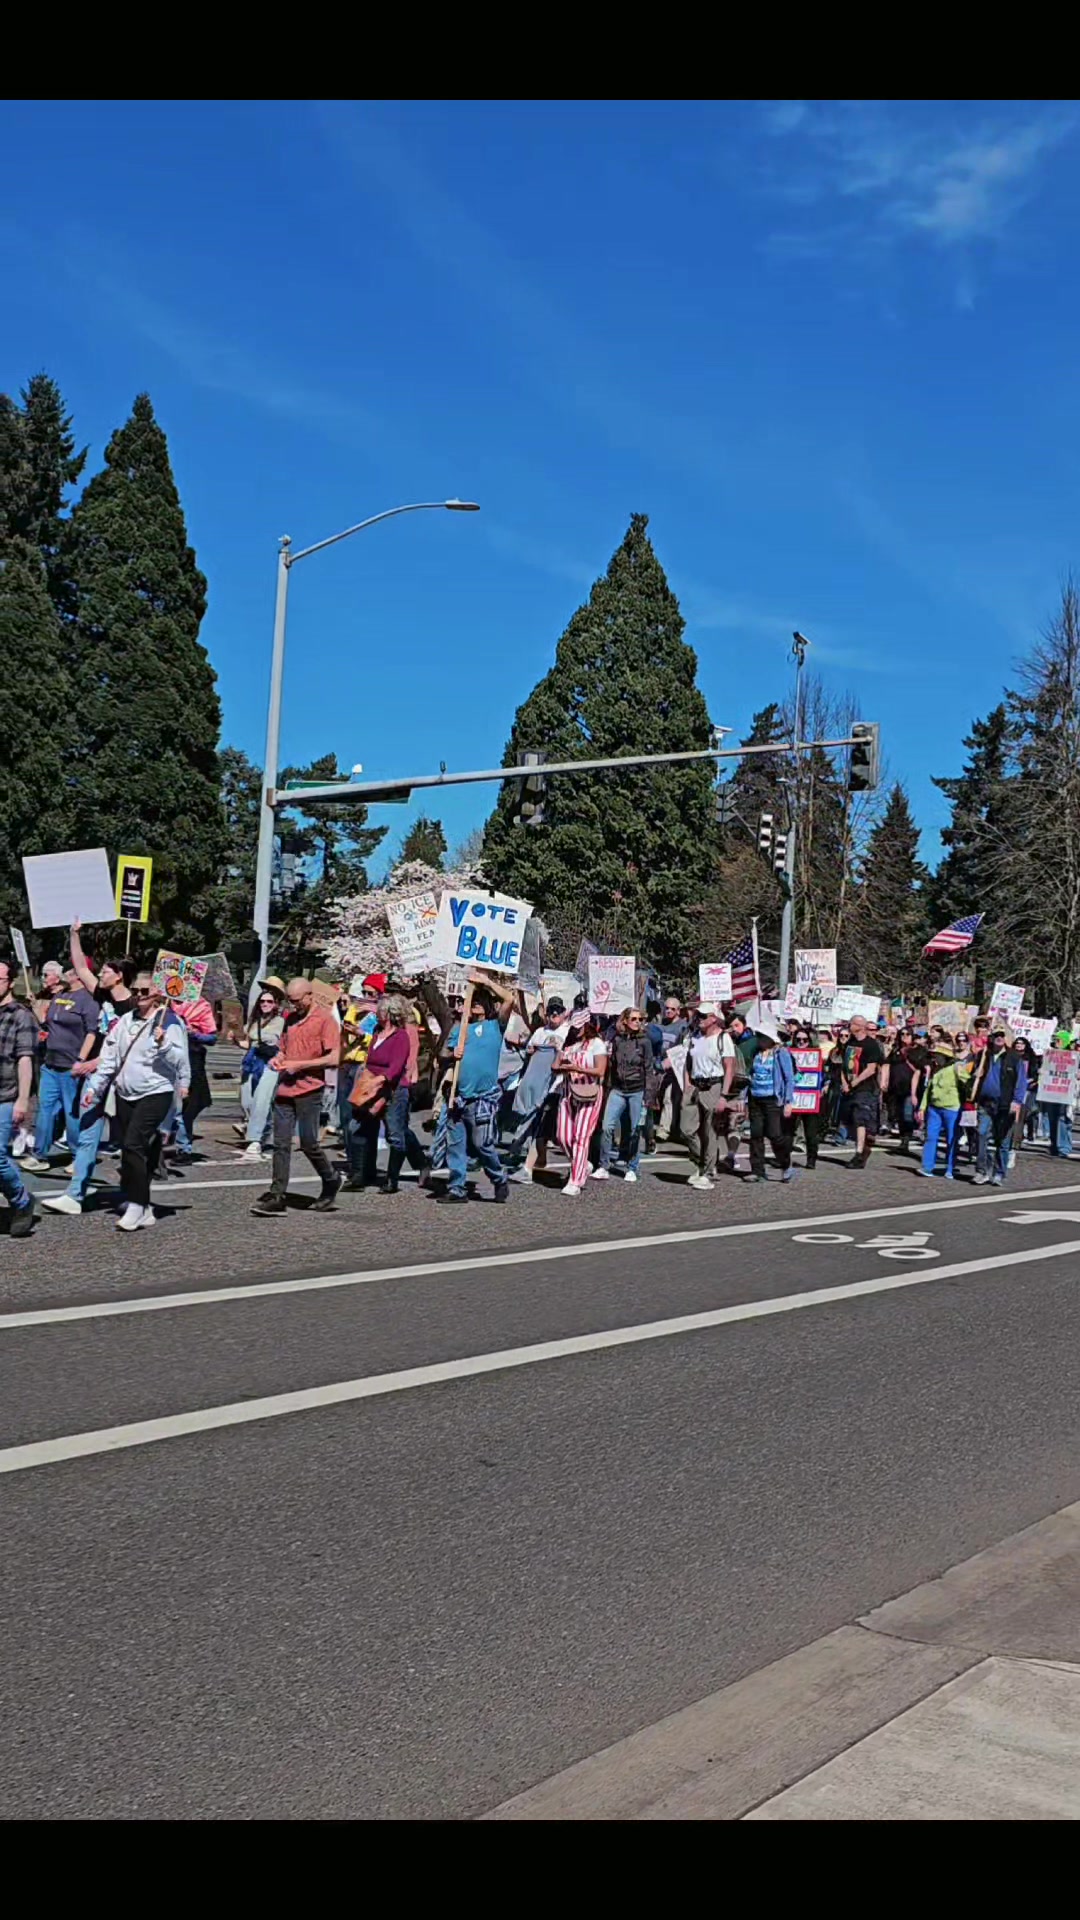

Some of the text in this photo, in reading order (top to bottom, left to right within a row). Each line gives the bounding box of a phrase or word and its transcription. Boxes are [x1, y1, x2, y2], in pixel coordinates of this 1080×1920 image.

[390, 896, 432, 916] NO ICE
[449, 897, 518, 928] VOTE
[394, 925, 406, 936] NO
[398, 936, 410, 946] NO
[456, 925, 520, 968] BLUE
[808, 986, 822, 996] NO
[799, 995, 834, 1008] KINGS!
[1011, 1018, 1046, 1029] HUGS!
